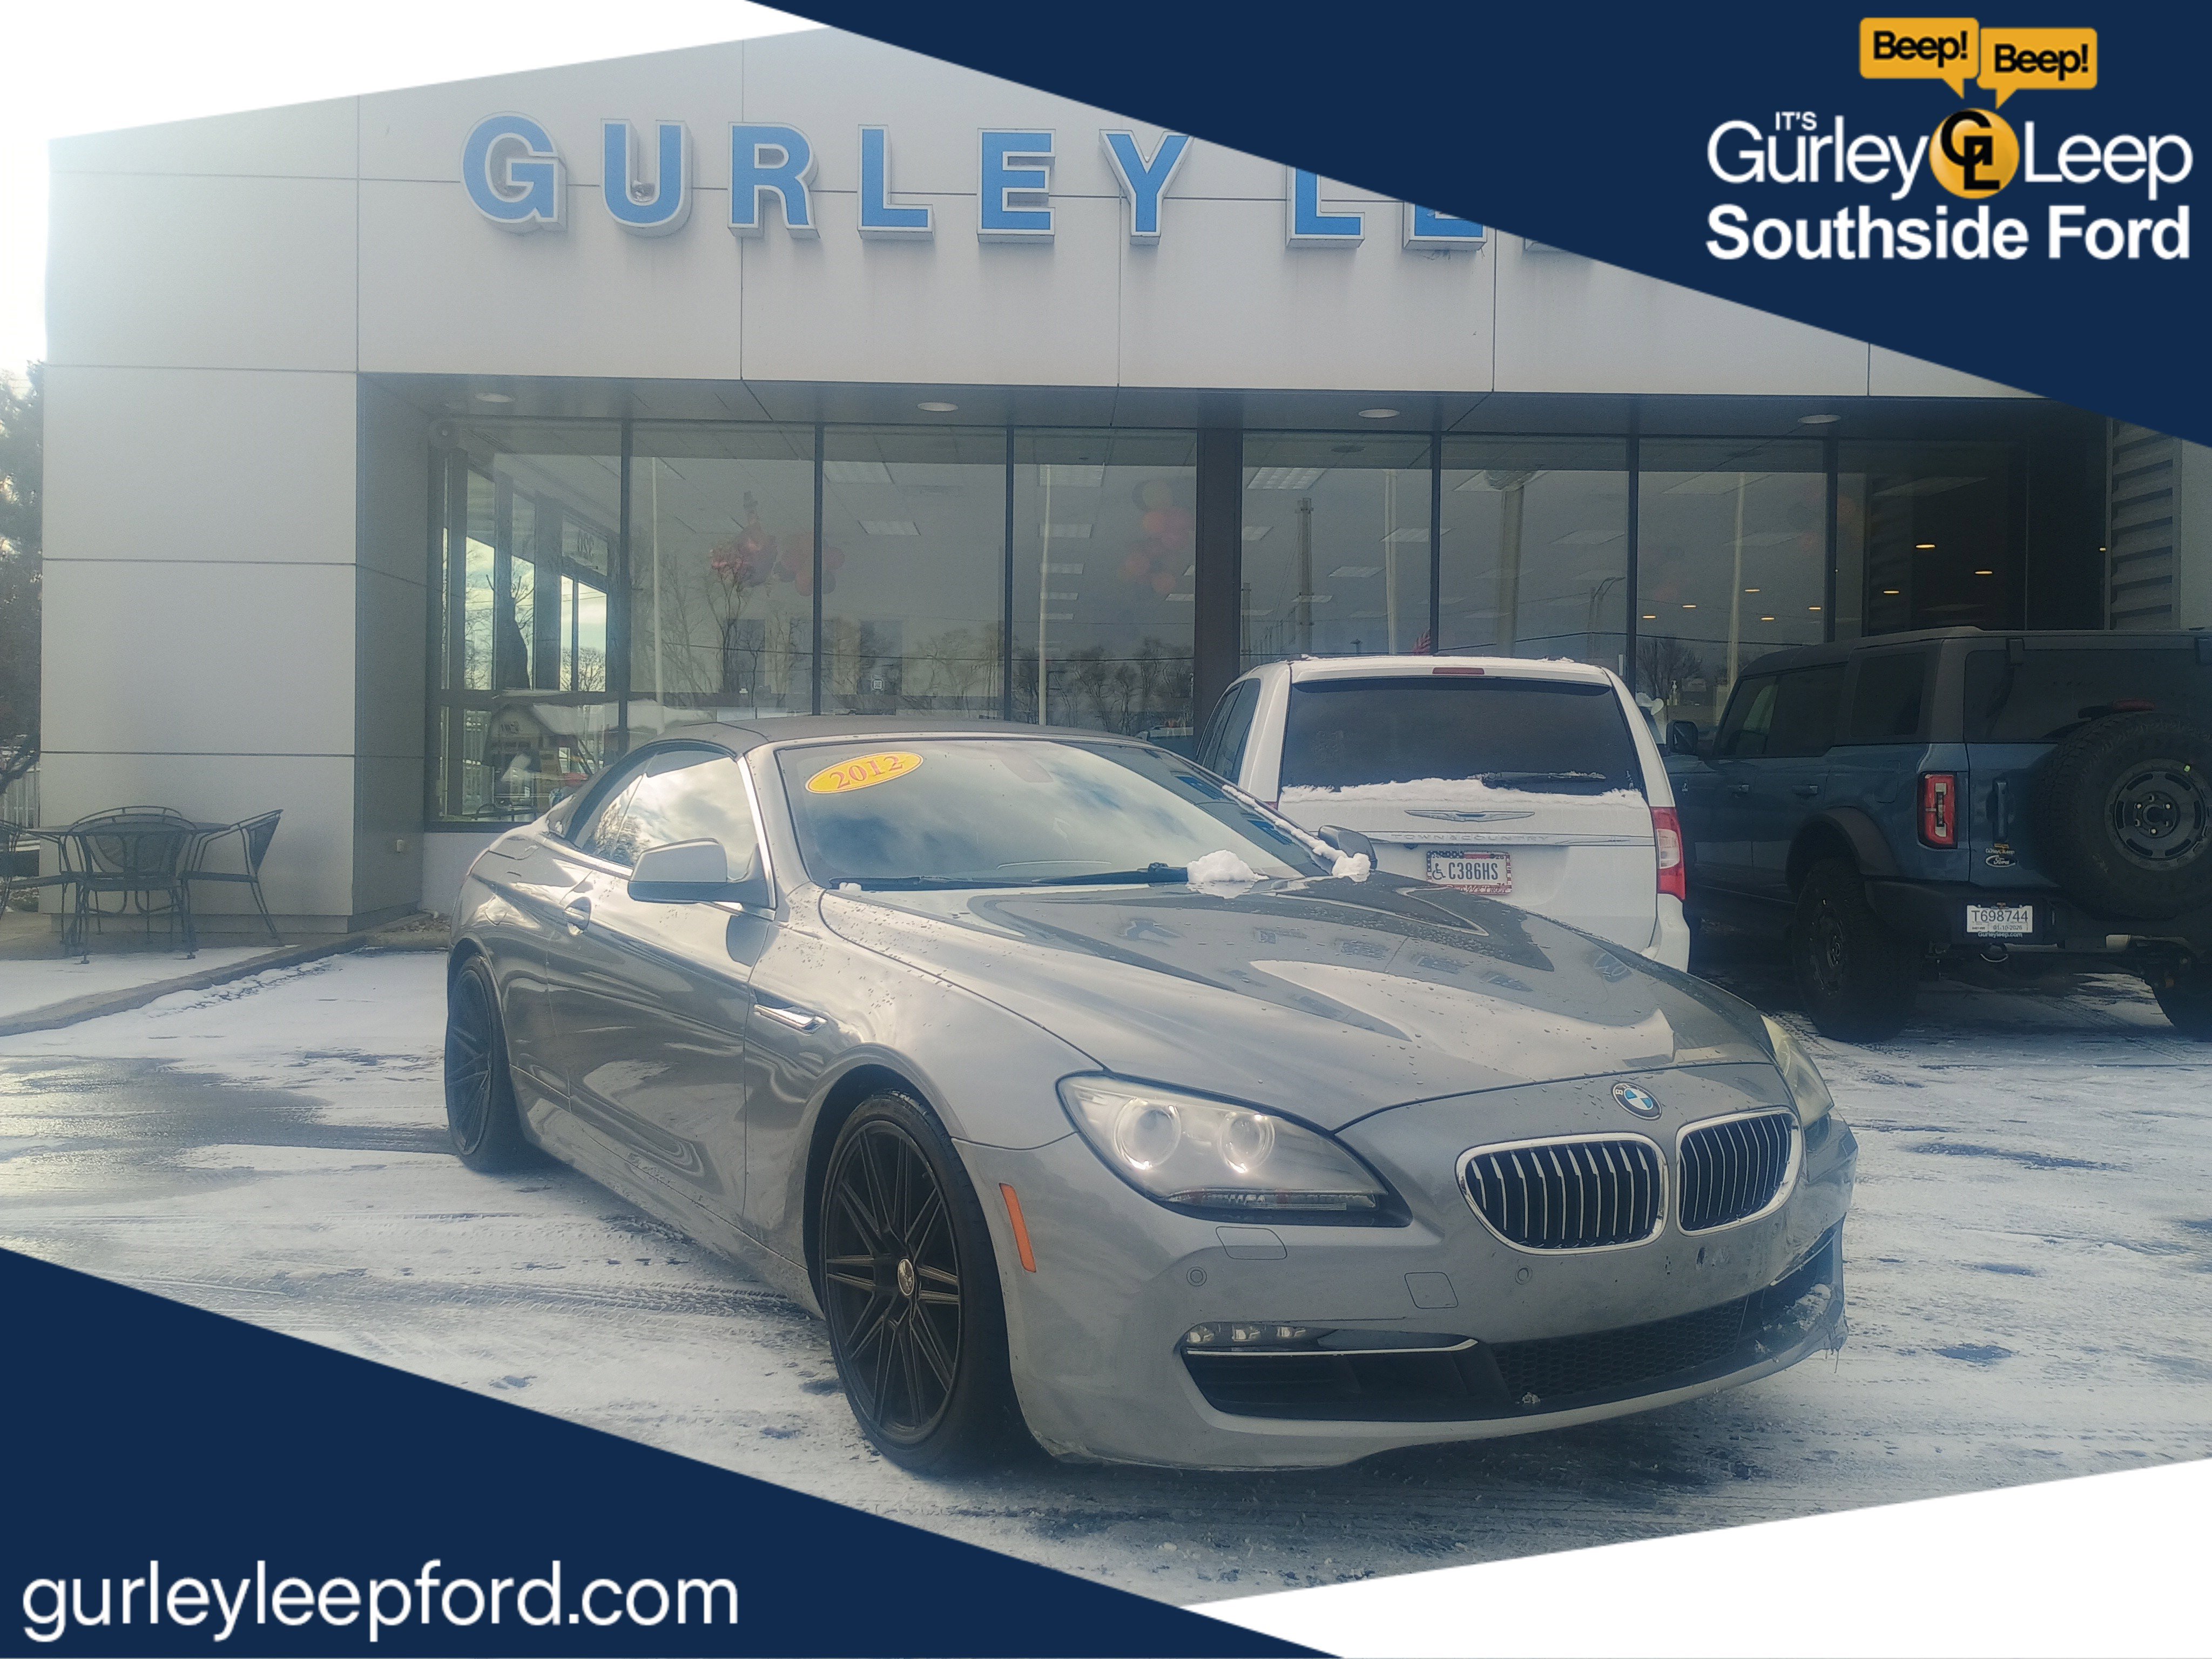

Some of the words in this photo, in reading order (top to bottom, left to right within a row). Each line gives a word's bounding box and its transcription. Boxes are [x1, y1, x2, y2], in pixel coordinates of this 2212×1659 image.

[460, 110, 1194, 245] GURLEY
[830, 756, 903, 788] 2012
[1448, 862, 1499, 880] C386HS
[1971, 910, 2028, 923] T698744
